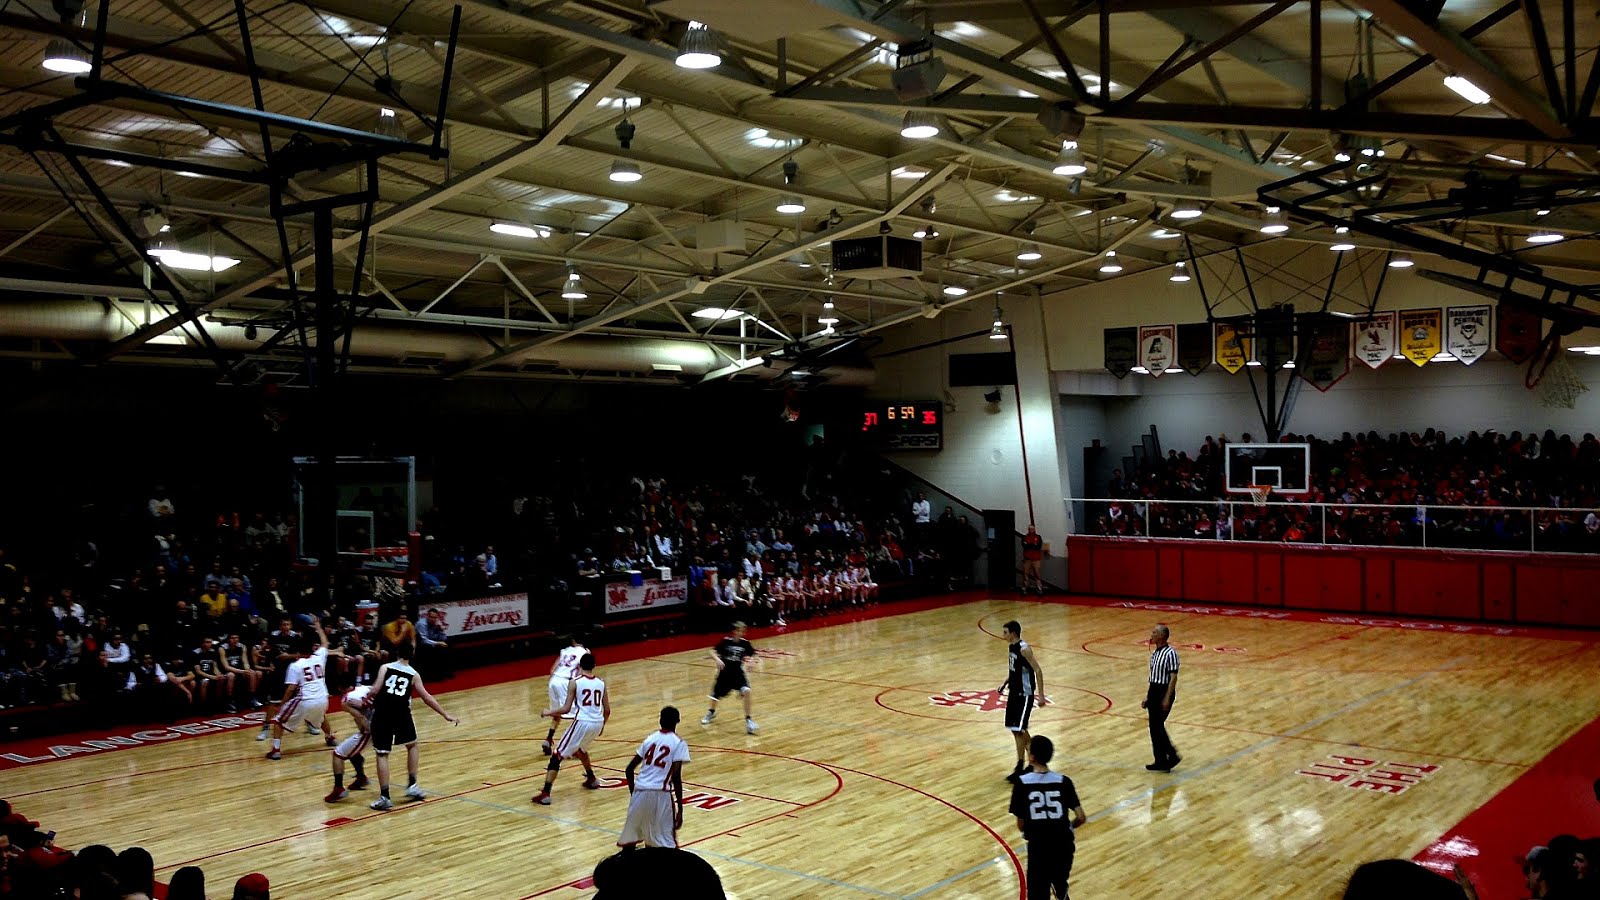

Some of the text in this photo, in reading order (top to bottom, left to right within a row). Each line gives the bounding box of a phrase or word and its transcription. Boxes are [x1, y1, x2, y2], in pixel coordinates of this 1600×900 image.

[888, 406, 915, 419] 6 59
[461, 610, 522, 631] LANCERS
[303, 664, 324, 681] 50
[385, 674, 409, 697] 43
[582, 689, 601, 707] 20
[0, 711, 272, 764] LANCERS
[644, 743, 671, 769] 42
[1028, 790, 1063, 820] 25
